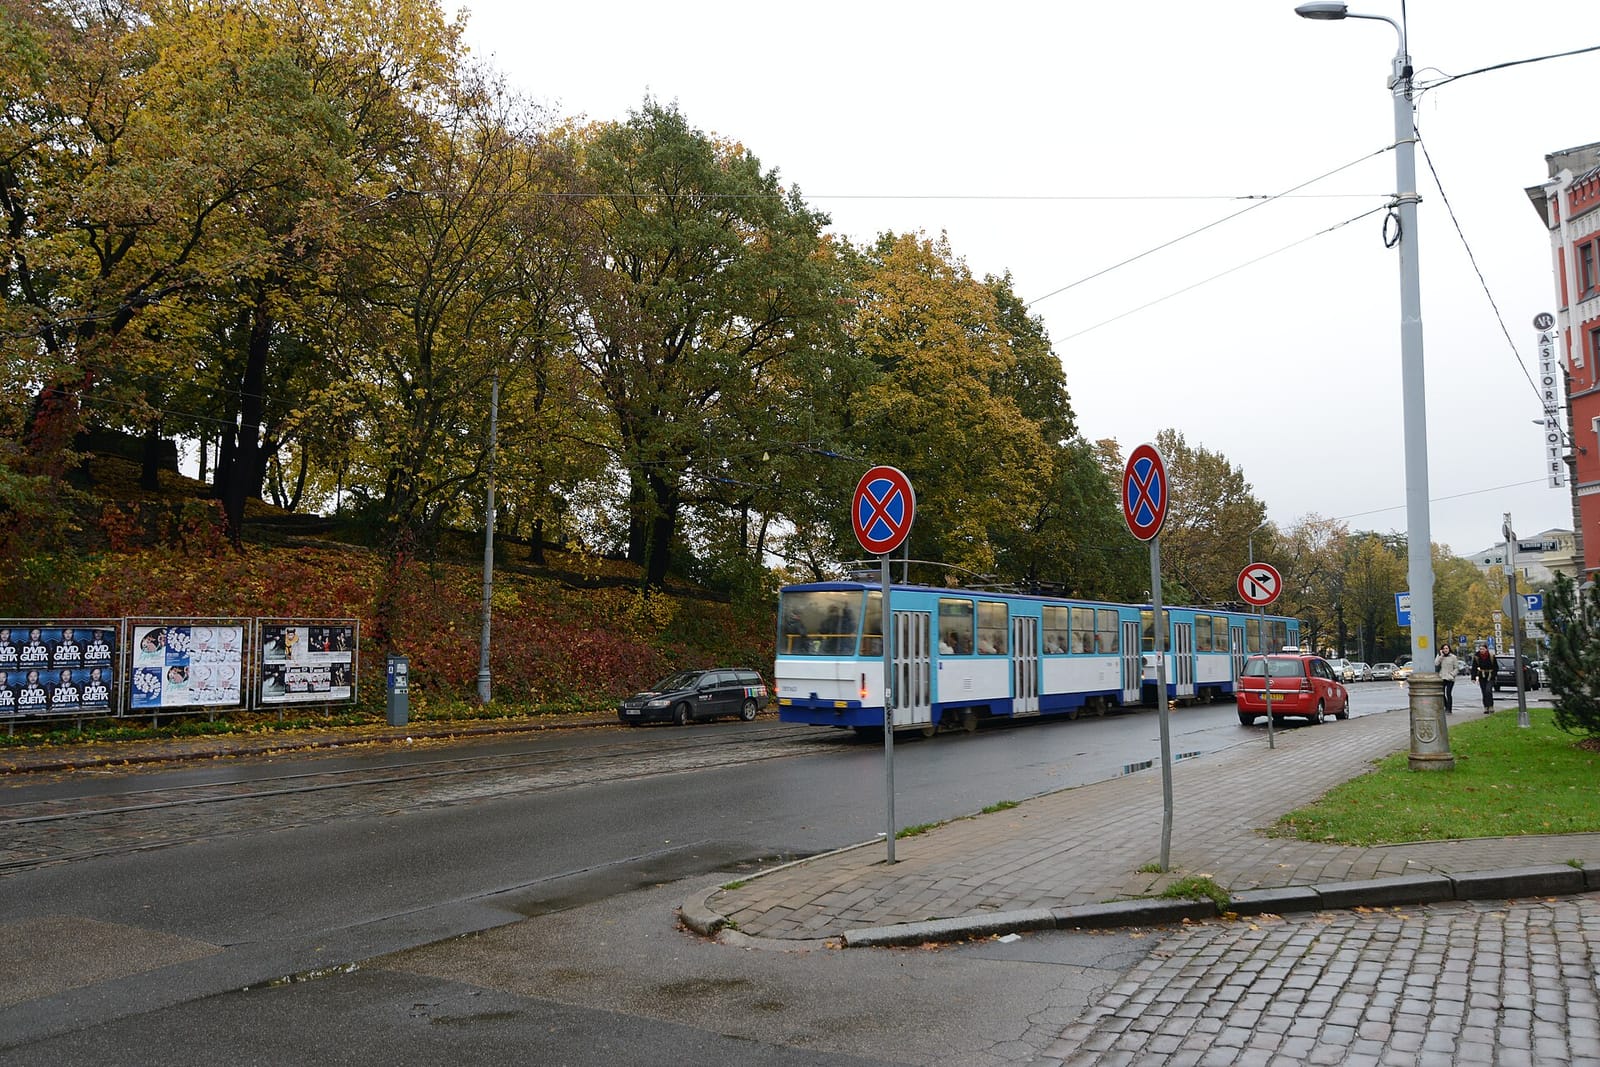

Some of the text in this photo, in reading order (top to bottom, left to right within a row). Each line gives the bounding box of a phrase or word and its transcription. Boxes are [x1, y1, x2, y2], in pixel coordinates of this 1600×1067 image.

[1540, 334, 1554, 400] ASTOR
[1547, 419, 1560, 486] HOTEL
[1527, 596, 1538, 609] P
[23, 646, 47, 654] DAVID
[56, 645, 79, 653] DAVID
[87, 644, 109, 652] DAVID
[20, 653, 49, 661] GUETTA
[53, 652, 81, 660] GUETTA
[84, 651, 111, 659] GUETTA
[21, 689, 45, 697] DAVID
[54, 687, 77, 695] DAVID
[84, 686, 107, 694] DAVID
[18, 696, 47, 705] GUETTA
[52, 694, 79, 703] GUETTA
[82, 692, 109, 701] GUETTA
